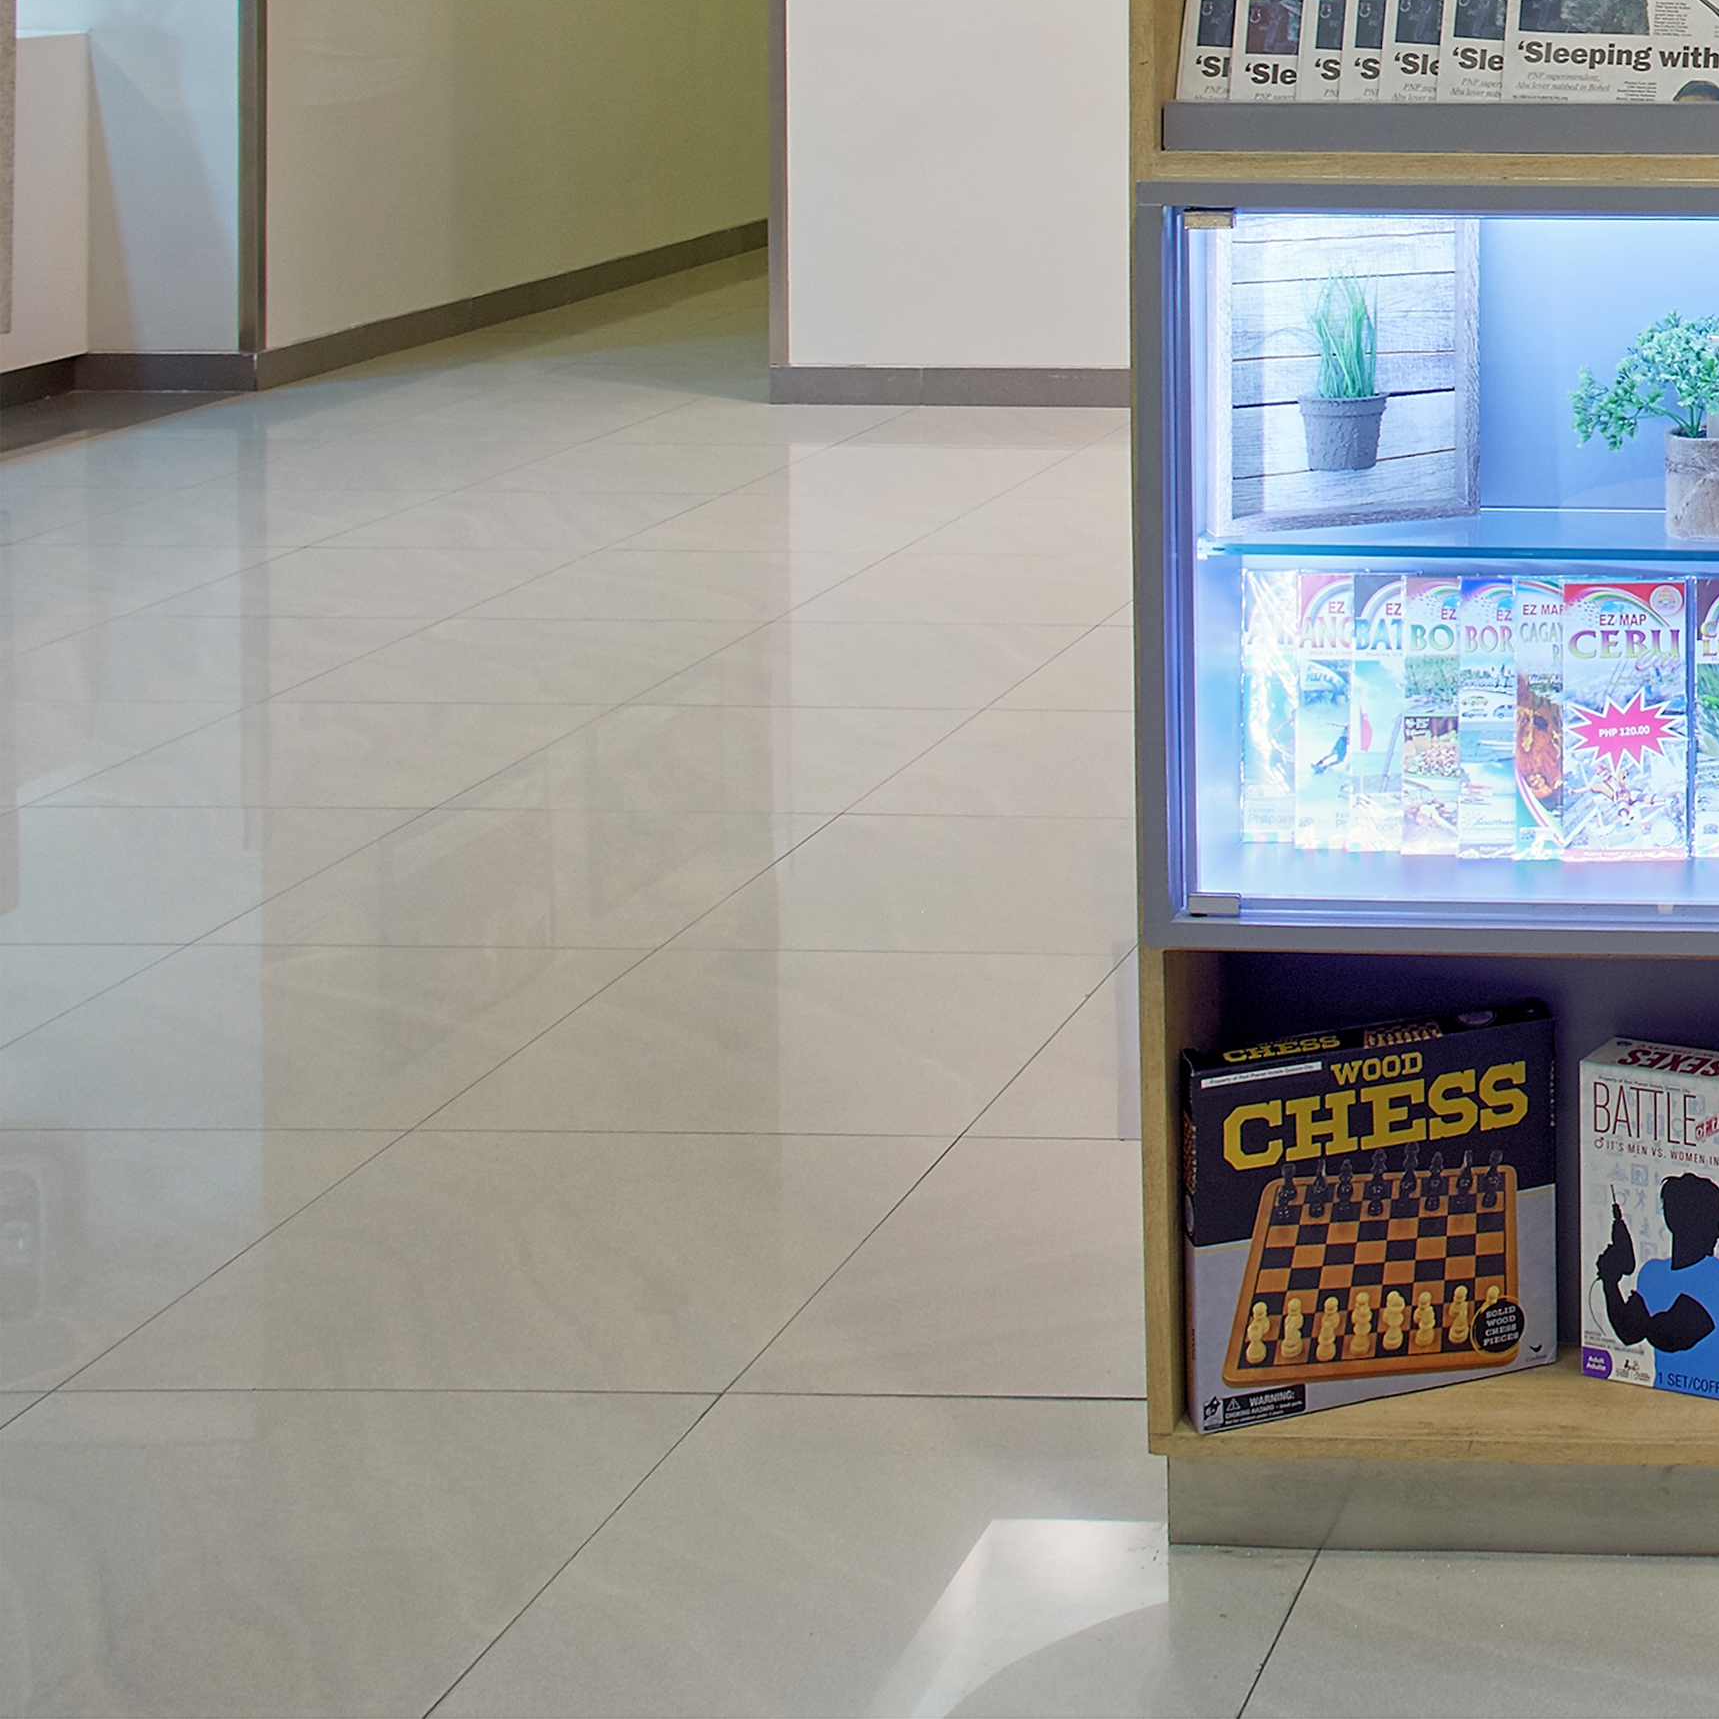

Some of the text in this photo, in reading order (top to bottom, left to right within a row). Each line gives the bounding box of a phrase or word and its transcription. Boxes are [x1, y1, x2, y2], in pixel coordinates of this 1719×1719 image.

[1659, 46, 1719, 70] with
[1599, 614, 1647, 626] EZ MAP
[1568, 628, 1682, 659] CEBU
[1598, 725, 1651, 737] PHP 120.00
[1330, 1052, 1423, 1085] WOOD
[1223, 1061, 1528, 1171] CHESS
[1594, 1082, 1697, 1147] BATTLE
[1695, 1125, 1707, 1141] of
